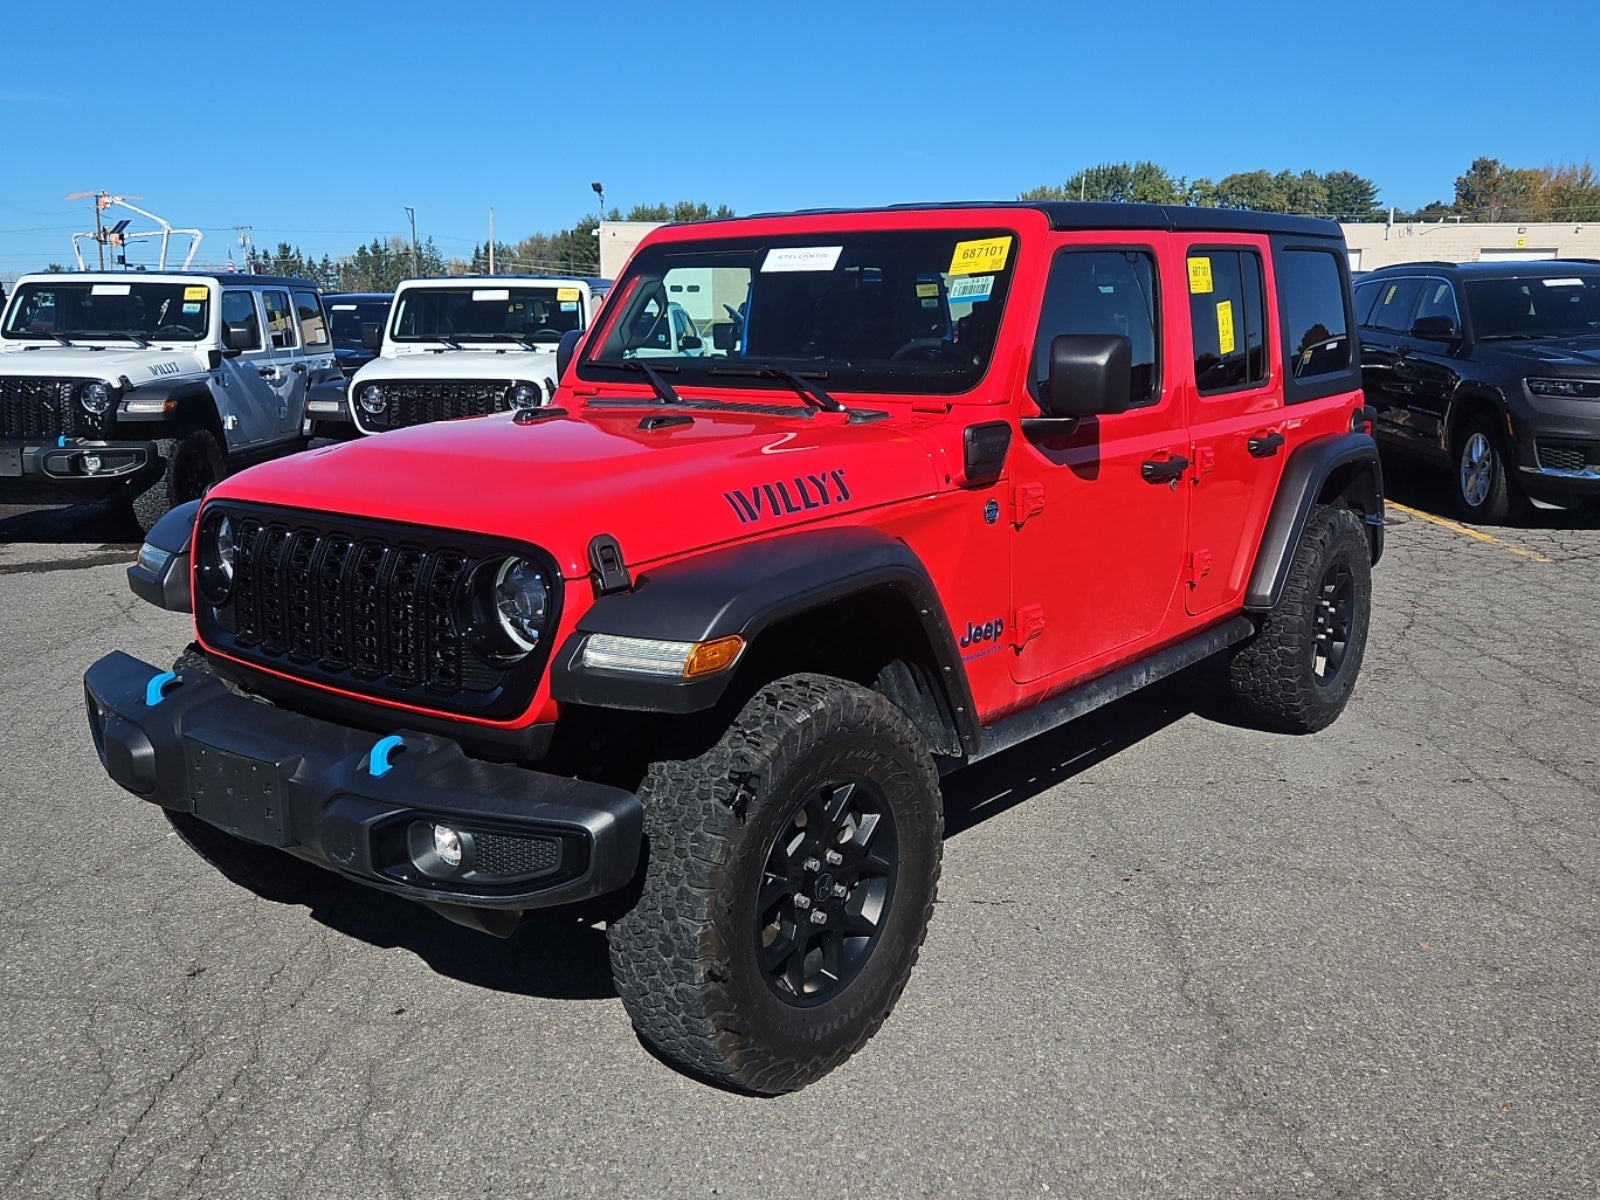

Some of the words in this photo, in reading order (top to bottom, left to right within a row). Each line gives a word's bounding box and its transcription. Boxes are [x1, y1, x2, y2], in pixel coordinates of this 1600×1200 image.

[962, 245, 1004, 259] 687101
[147, 362, 180, 376] WILLYS
[722, 469, 850, 524] WILLYS
[960, 618, 1004, 648] Jeep
